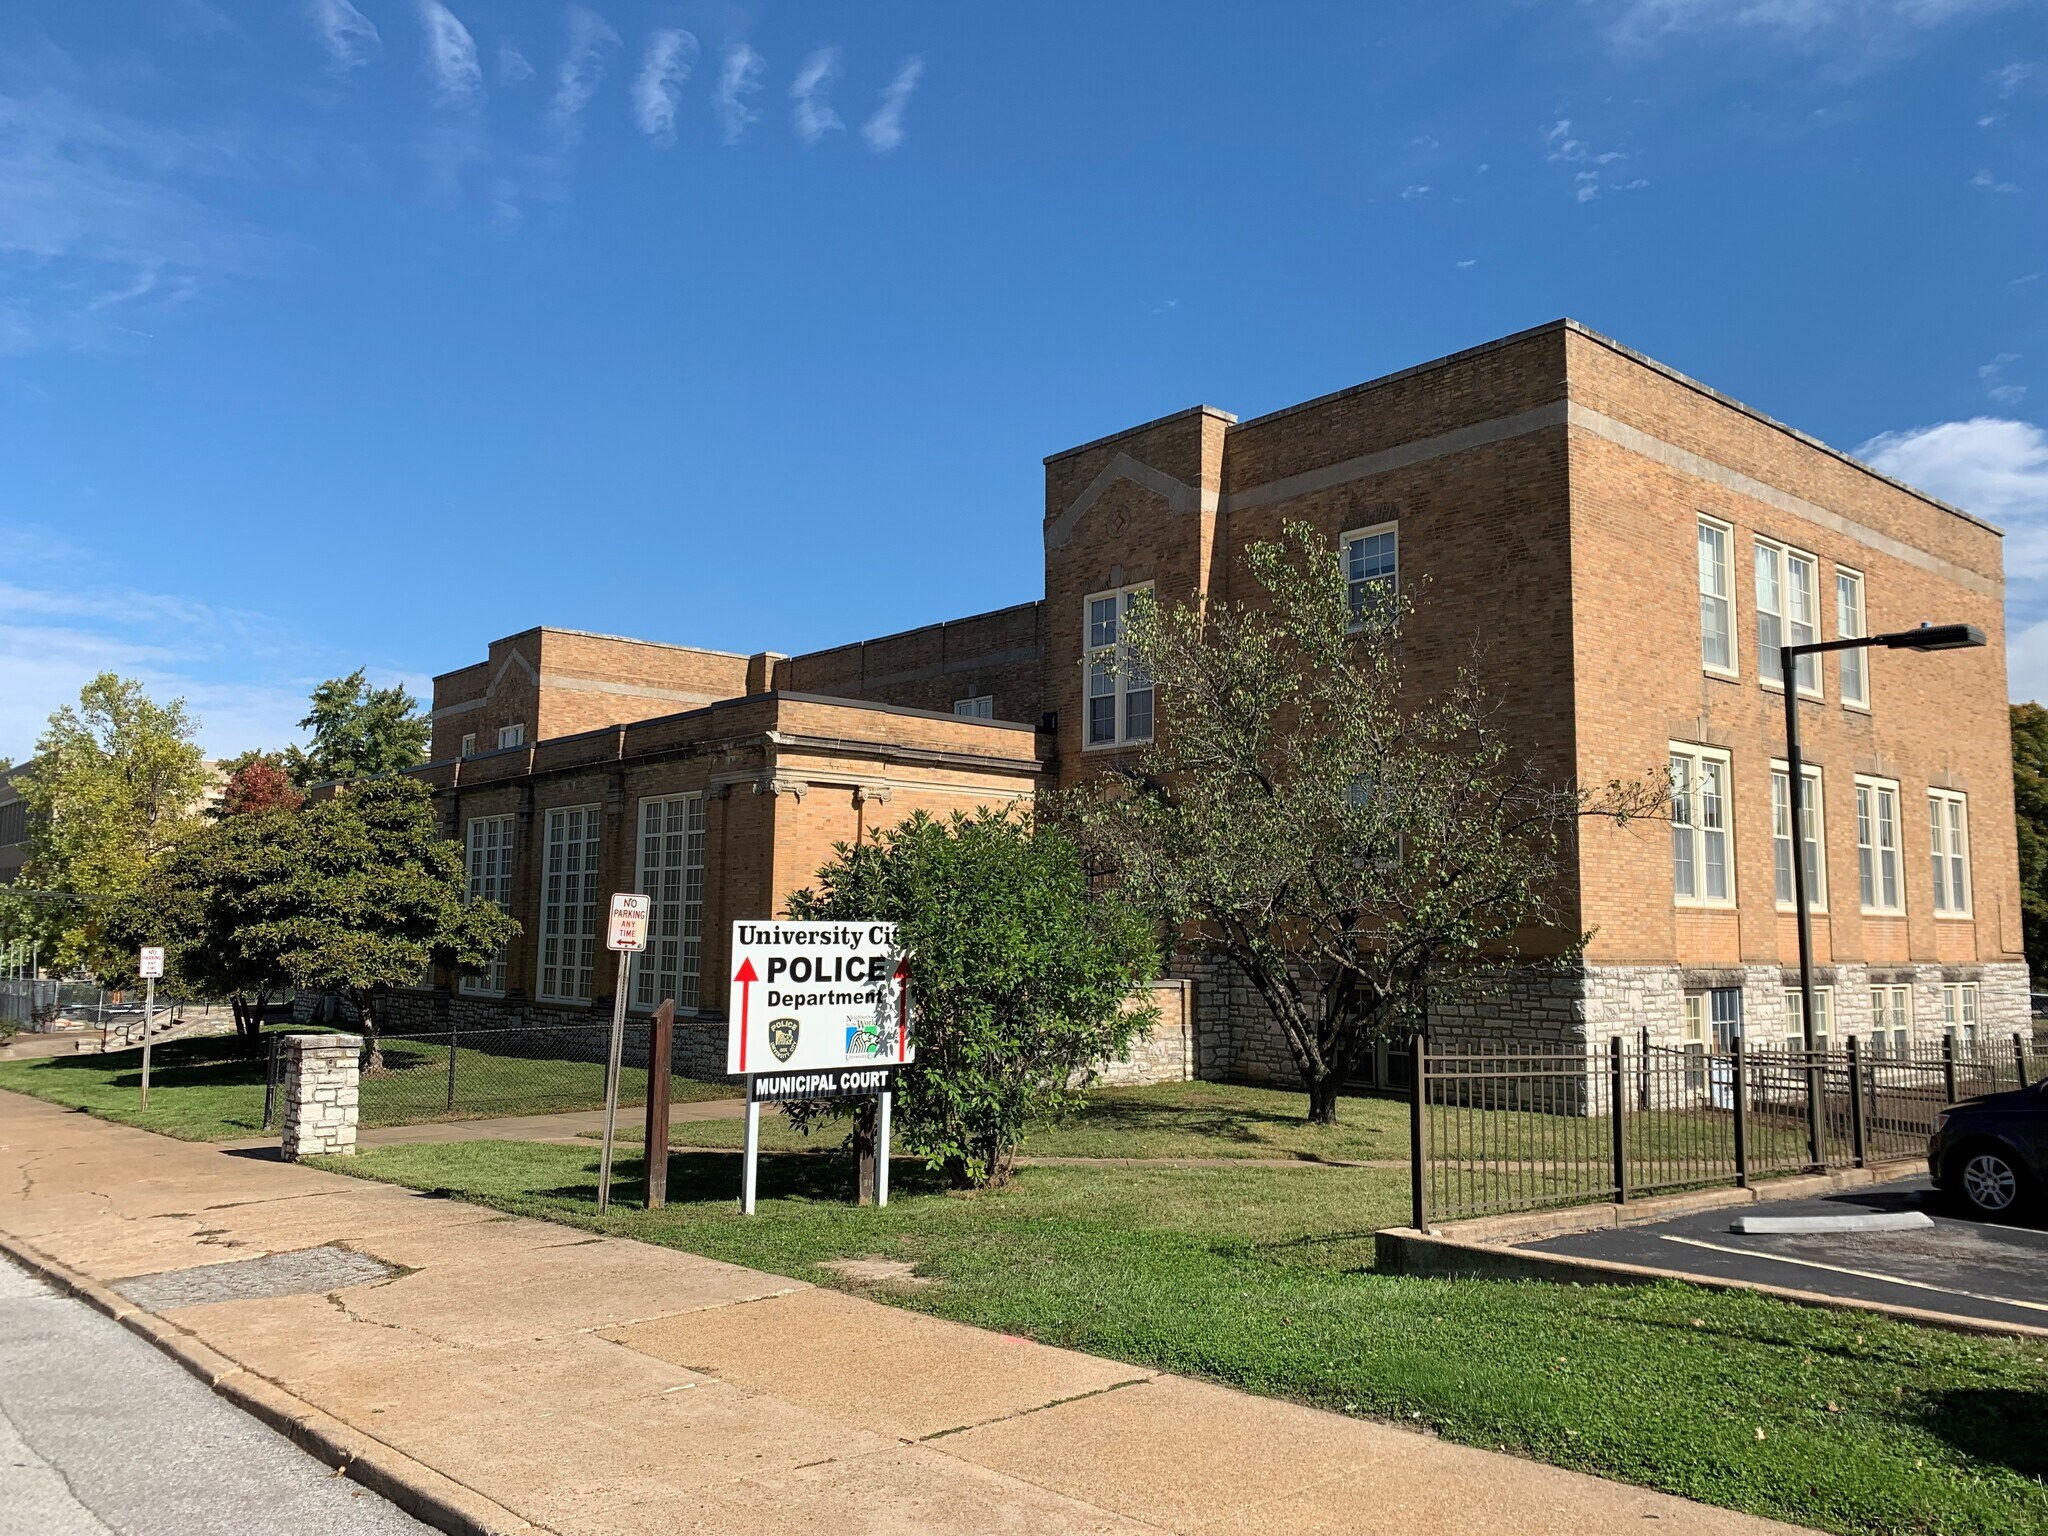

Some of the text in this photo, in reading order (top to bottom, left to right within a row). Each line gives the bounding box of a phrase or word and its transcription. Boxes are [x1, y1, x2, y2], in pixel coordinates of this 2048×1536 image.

[623, 898, 638, 908] NO
[613, 909, 646, 919] PARKING
[738, 925, 900, 950] University Cit
[767, 957, 886, 983] POLICE
[768, 990, 884, 1010] Department
[770, 1020, 798, 1032] POLICE
[756, 1070, 889, 1096] MUNICIPAL COURT
